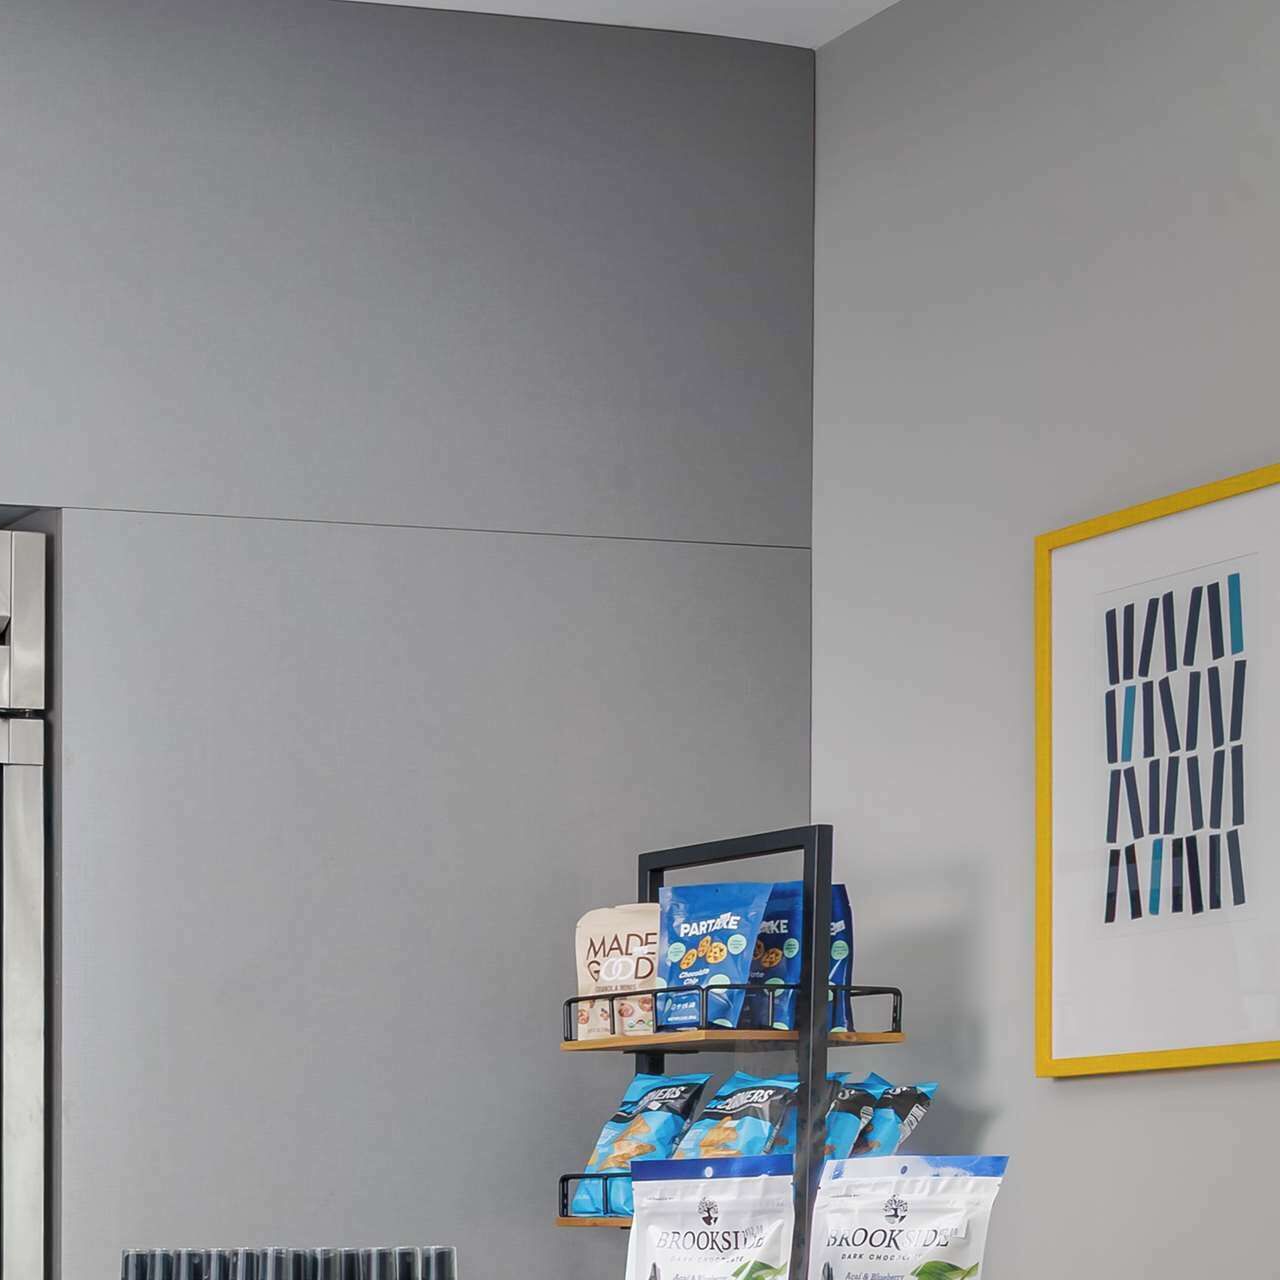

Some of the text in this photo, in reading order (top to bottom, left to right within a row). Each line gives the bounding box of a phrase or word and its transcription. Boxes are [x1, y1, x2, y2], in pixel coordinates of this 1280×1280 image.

[680, 911, 741, 937] PARTAKE
[586, 932, 658, 960] MADE
[587, 956, 654, 982] GOOD
[679, 967, 710, 979] Chocolate
